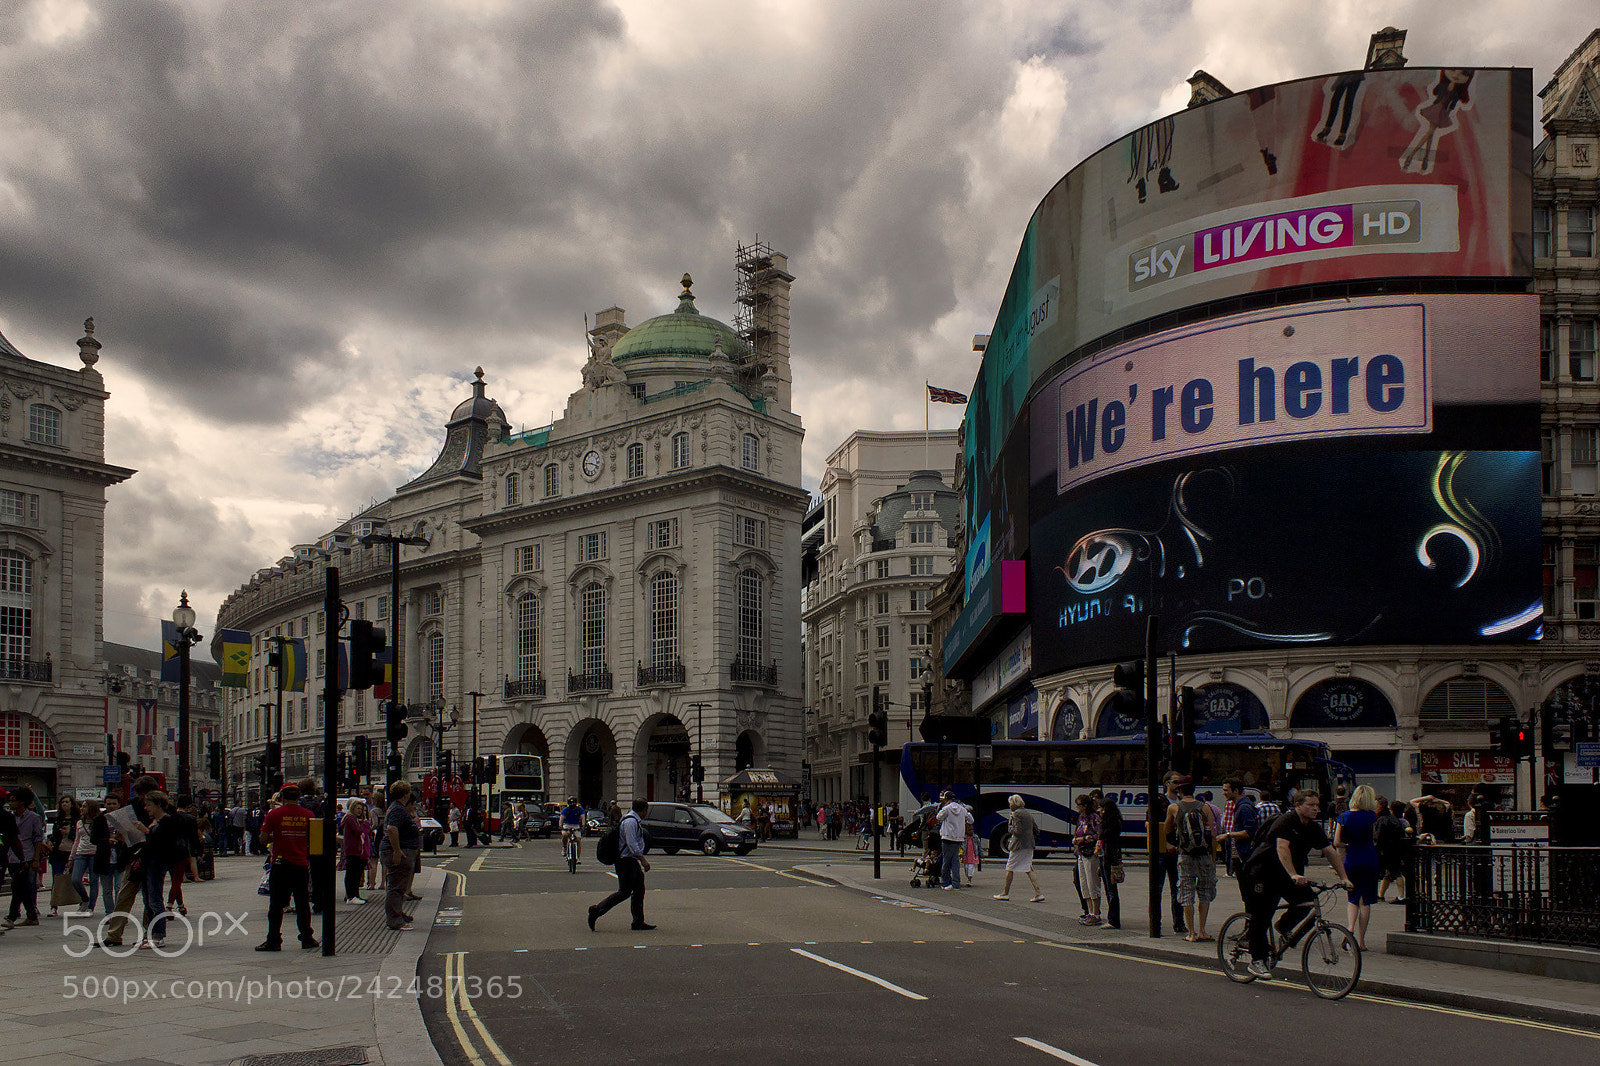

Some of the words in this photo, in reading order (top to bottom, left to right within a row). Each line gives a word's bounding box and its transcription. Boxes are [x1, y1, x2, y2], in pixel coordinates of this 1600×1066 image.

[1134, 243, 1187, 283] sky
[1202, 211, 1344, 266] LIVING
[1362, 211, 1411, 238] HD
[1065, 378, 1214, 471] We're
[1238, 354, 1405, 426] here
[1209, 698, 1235, 713] GAP
[1329, 693, 1358, 709] GAP
[1452, 751, 1481, 768] SALE
[251, 809, 261, 818] 12
